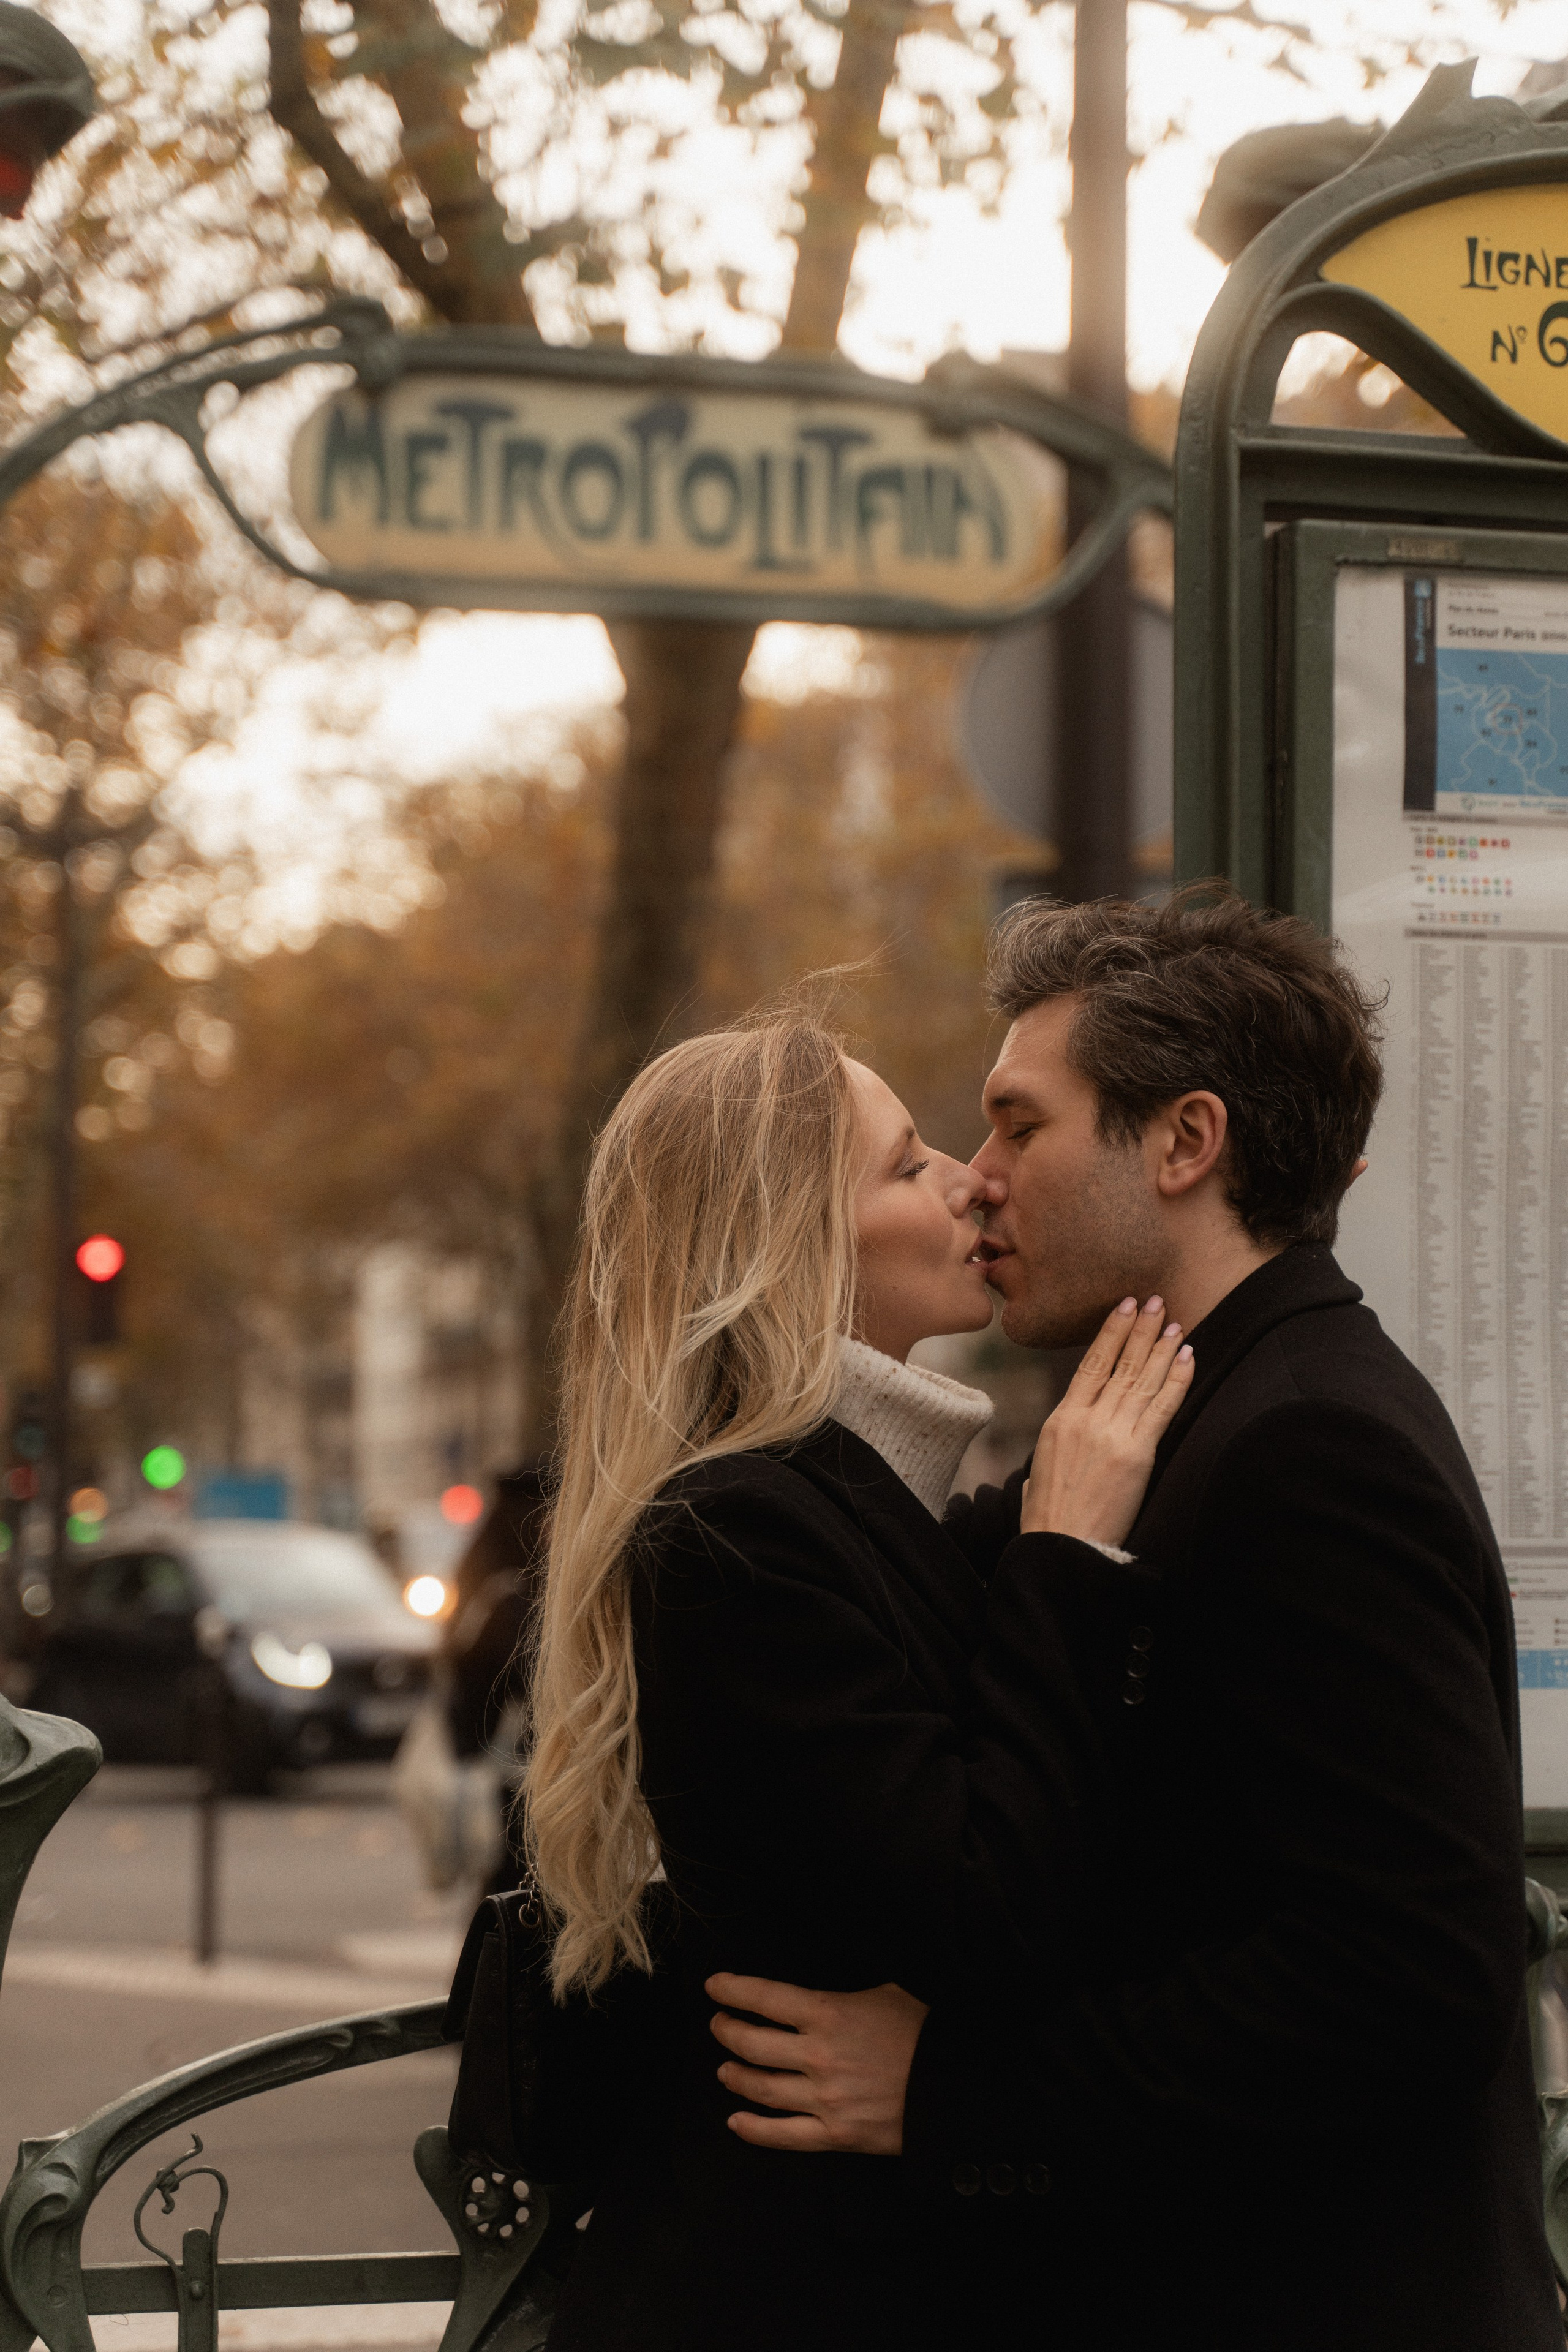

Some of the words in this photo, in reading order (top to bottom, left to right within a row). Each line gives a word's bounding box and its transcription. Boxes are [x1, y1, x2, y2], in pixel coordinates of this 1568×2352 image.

[1539, 301, 1568, 368] 6
[1448, 624, 1498, 638] Secteur
[1504, 627, 1536, 639] Paris
